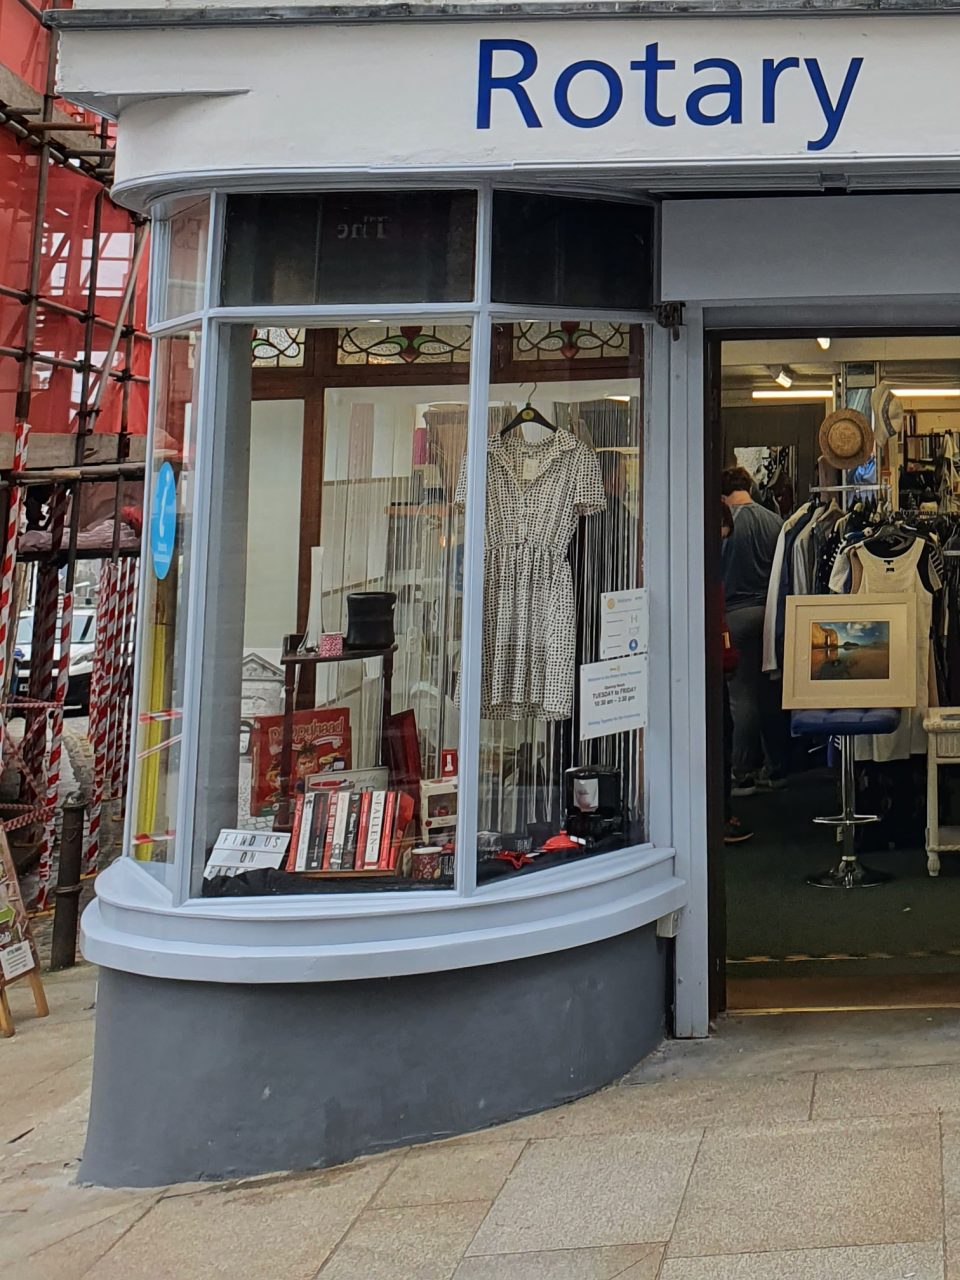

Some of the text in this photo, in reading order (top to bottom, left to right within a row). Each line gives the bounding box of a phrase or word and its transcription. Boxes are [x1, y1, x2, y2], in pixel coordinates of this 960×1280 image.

[476, 40, 861, 151] Rotary
[592, 689, 614, 699] TUESDAY
[619, 686, 637, 694] FRIDAY
[223, 833, 281, 849] FIND US
[240, 851, 257, 864] ON
